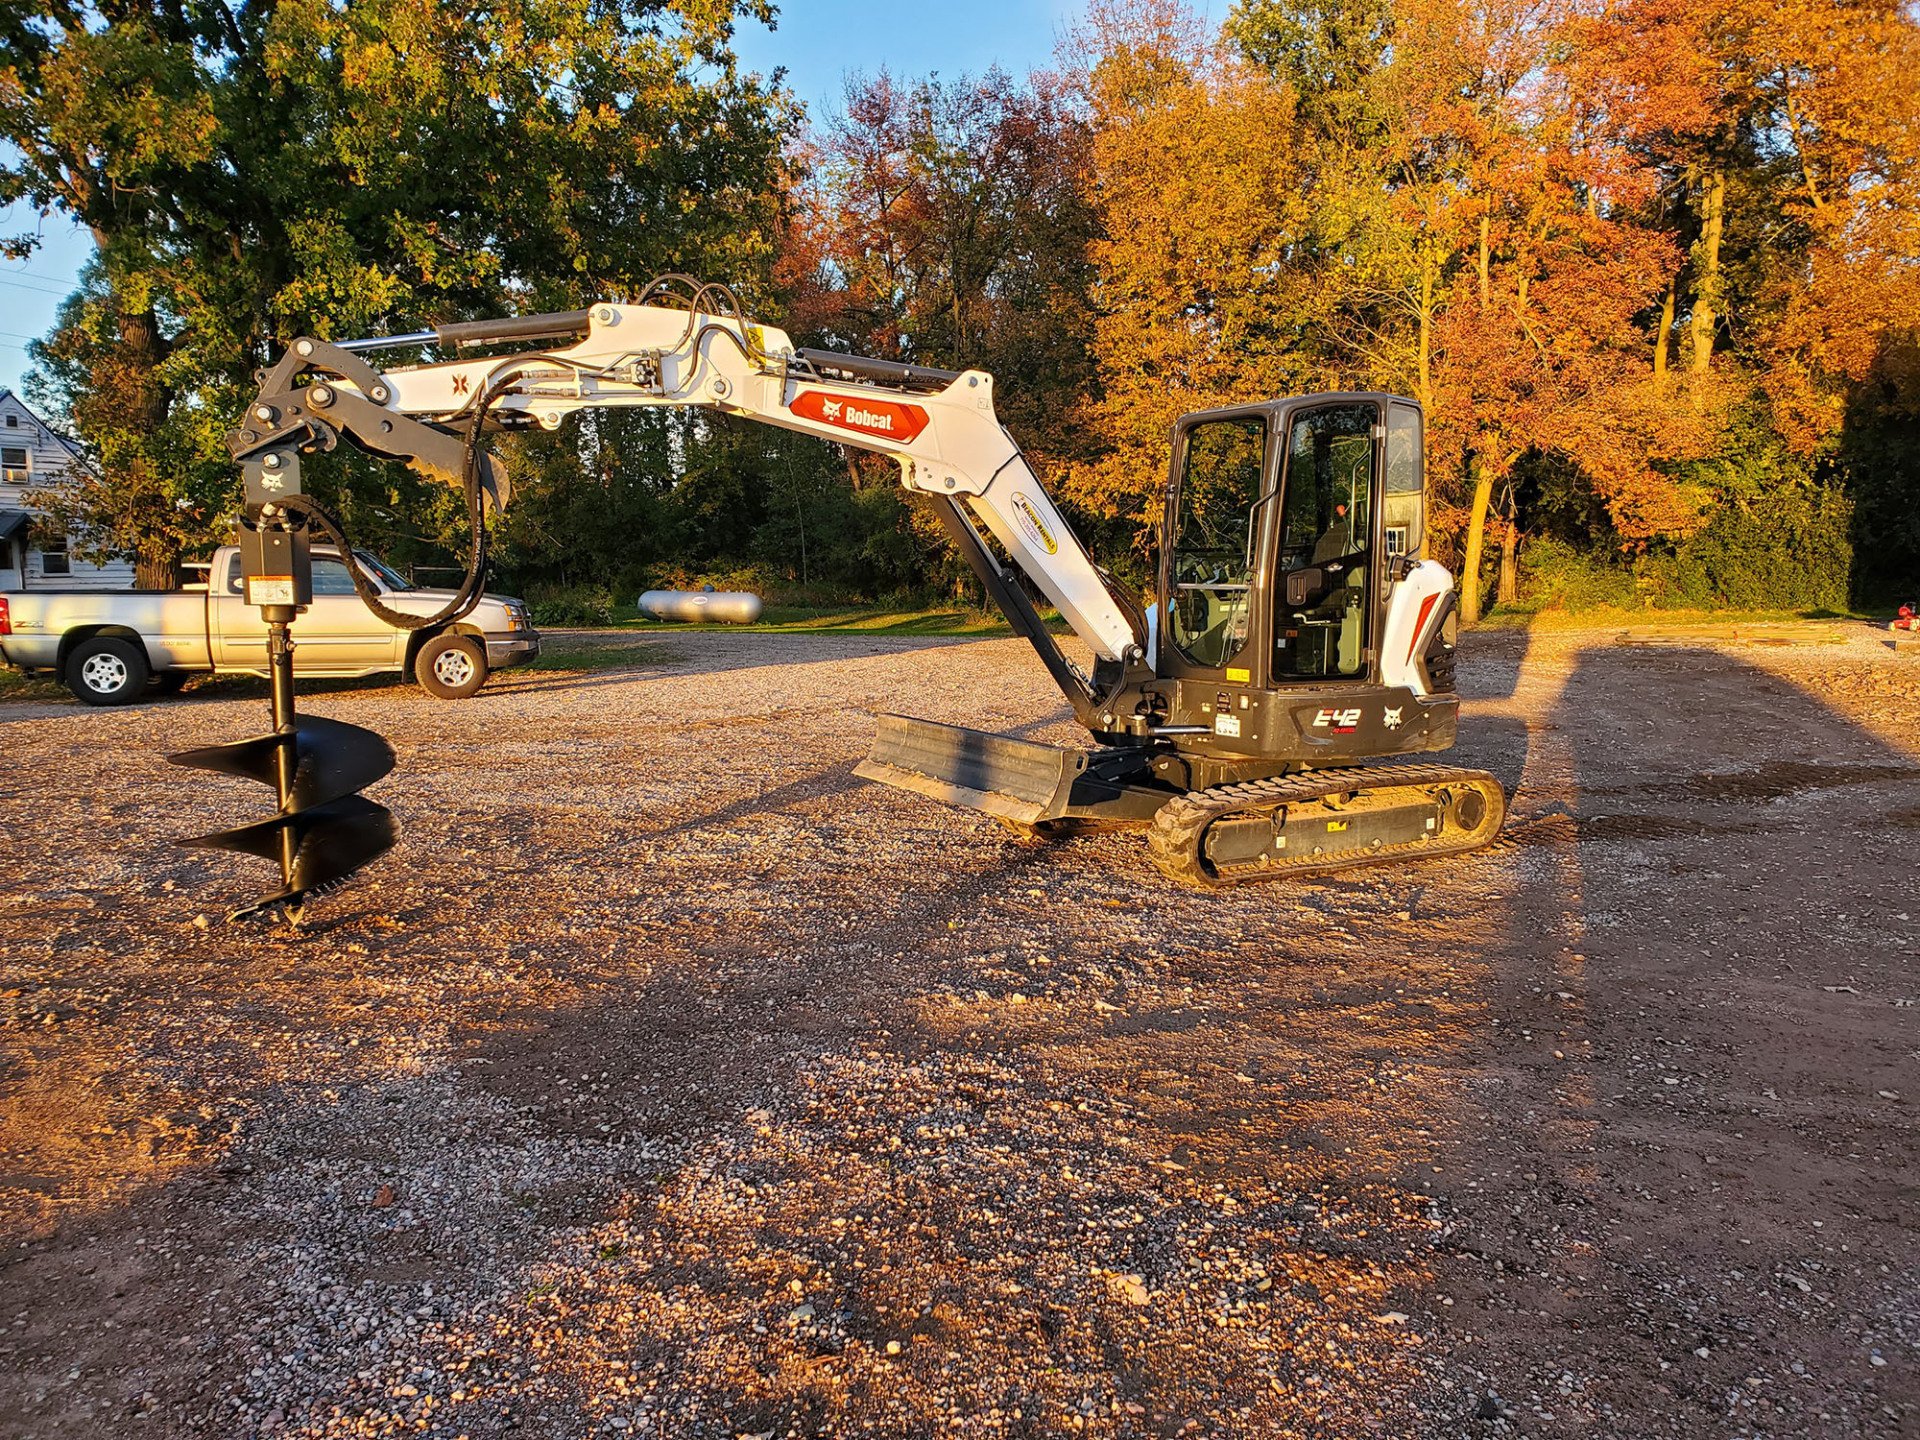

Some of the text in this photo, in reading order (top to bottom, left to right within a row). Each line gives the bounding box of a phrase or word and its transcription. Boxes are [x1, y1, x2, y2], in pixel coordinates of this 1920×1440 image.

[845, 406, 893, 430] Bobcat
[1021, 502, 1039, 526] BEACON
[1037, 524, 1055, 550] RENTALS
[1312, 708, 1361, 727] E42
